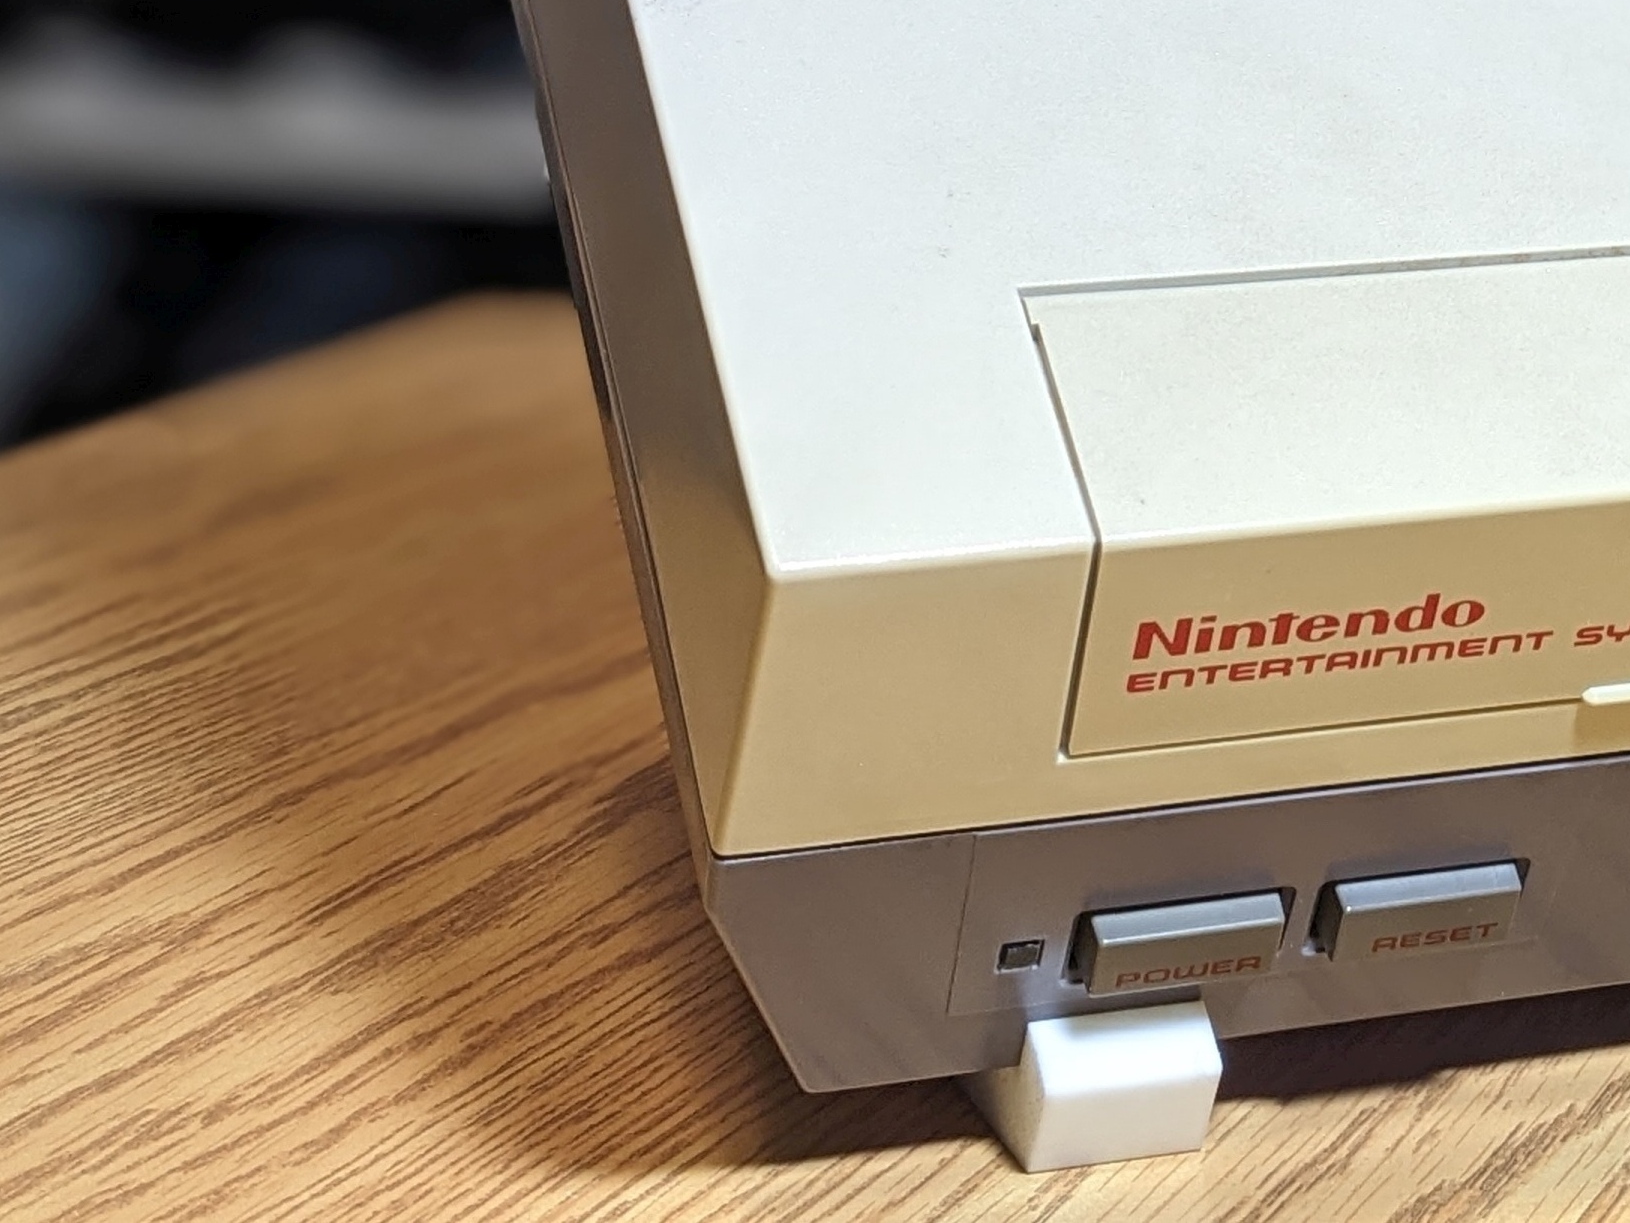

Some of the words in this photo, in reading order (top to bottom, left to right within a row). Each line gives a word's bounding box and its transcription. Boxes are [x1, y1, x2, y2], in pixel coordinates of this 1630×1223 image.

[1132, 592, 1485, 661] Nintendo
[1126, 630, 1554, 694] ENTERTAINMENT
[1371, 922, 1499, 953] RESET
[1115, 955, 1262, 989] POWER
